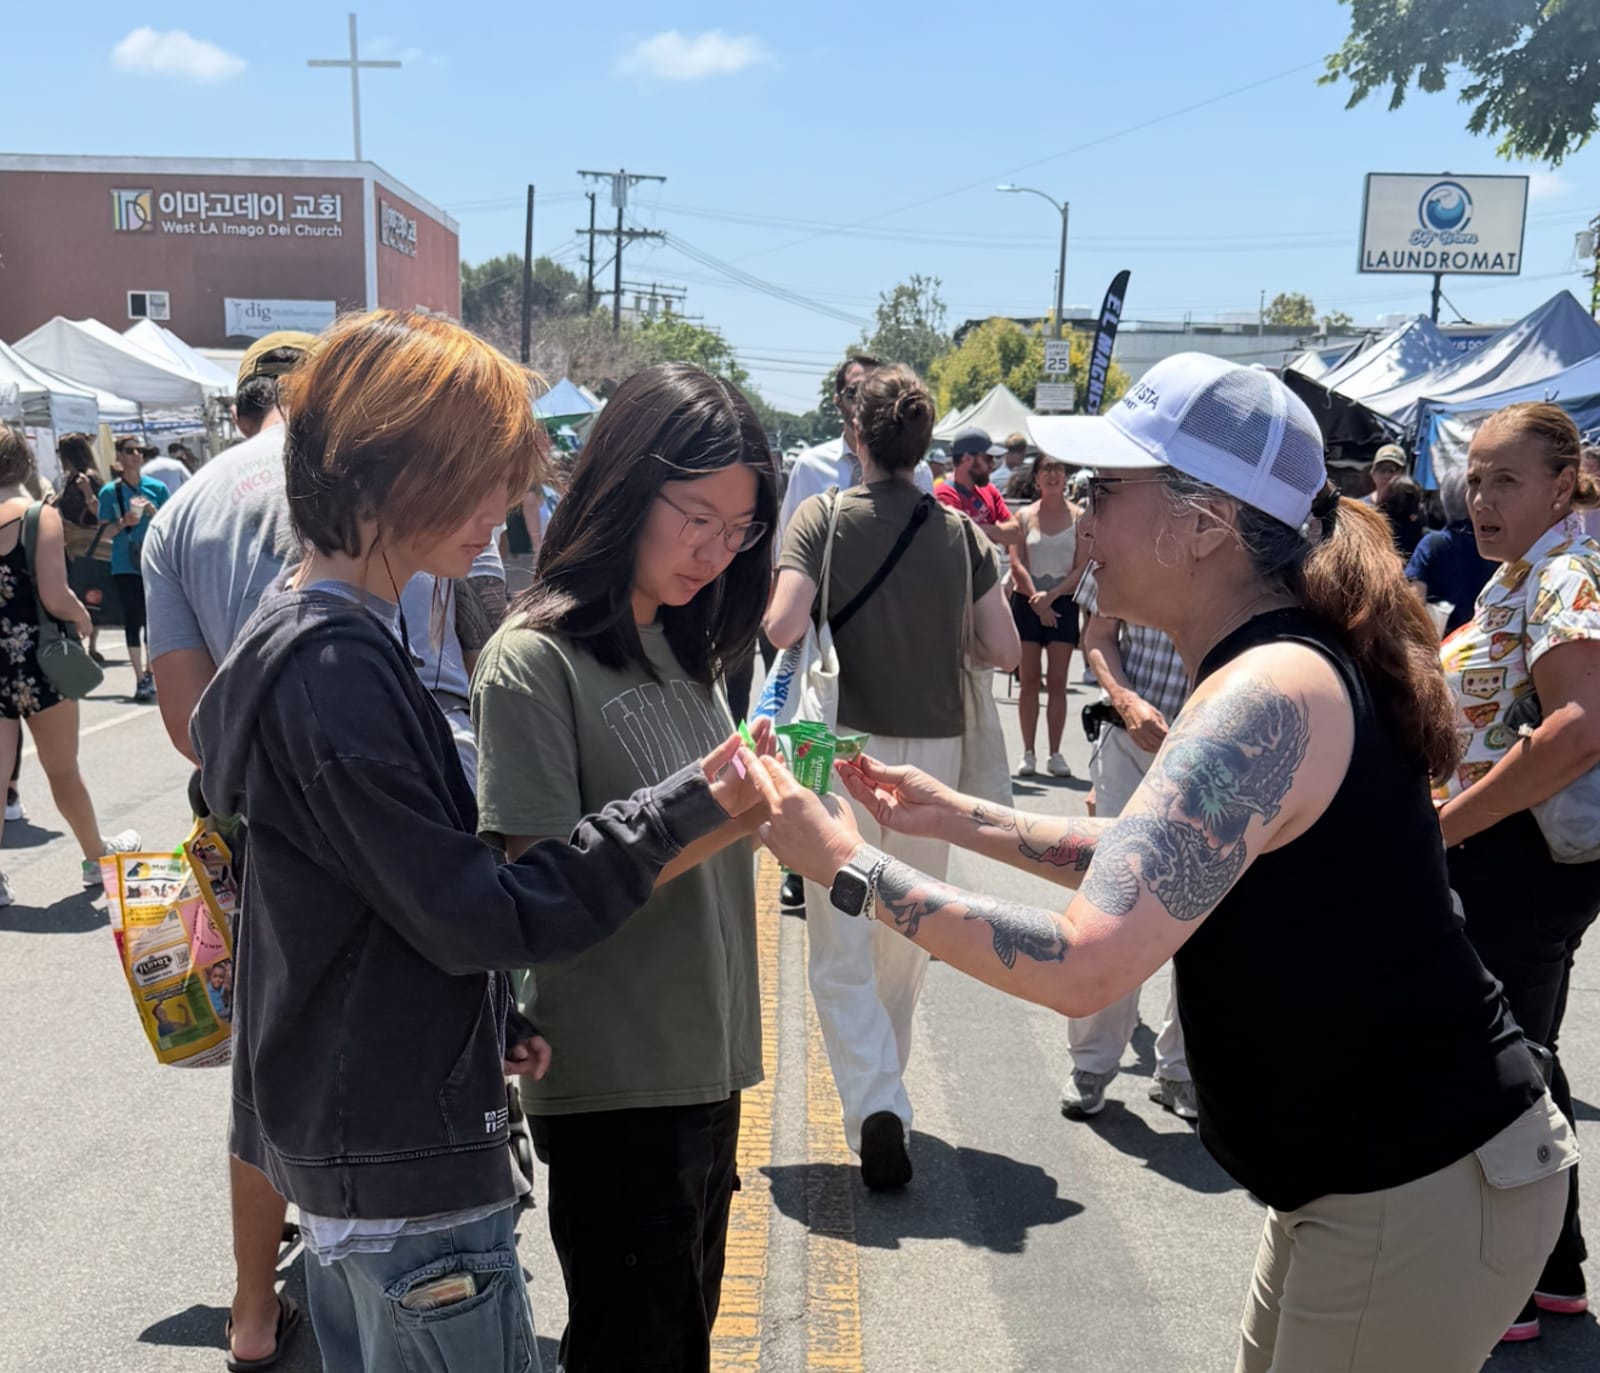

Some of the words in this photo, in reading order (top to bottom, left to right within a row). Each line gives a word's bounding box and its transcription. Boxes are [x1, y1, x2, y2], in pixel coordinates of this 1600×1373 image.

[159, 191, 284, 221] 이마고데이
[290, 194, 342, 222] 교회
[162, 221, 195, 233] West
[200, 222, 218, 234] LA
[223, 223, 264, 237] Imago
[268, 224, 290, 236] Dei
[295, 224, 342, 237] Church
[1366, 250, 1516, 270] LAUNDROMAT
[245, 302, 272, 321] dig
[1102, 293, 1122, 327] EL
[1047, 358, 1067, 371] 25
